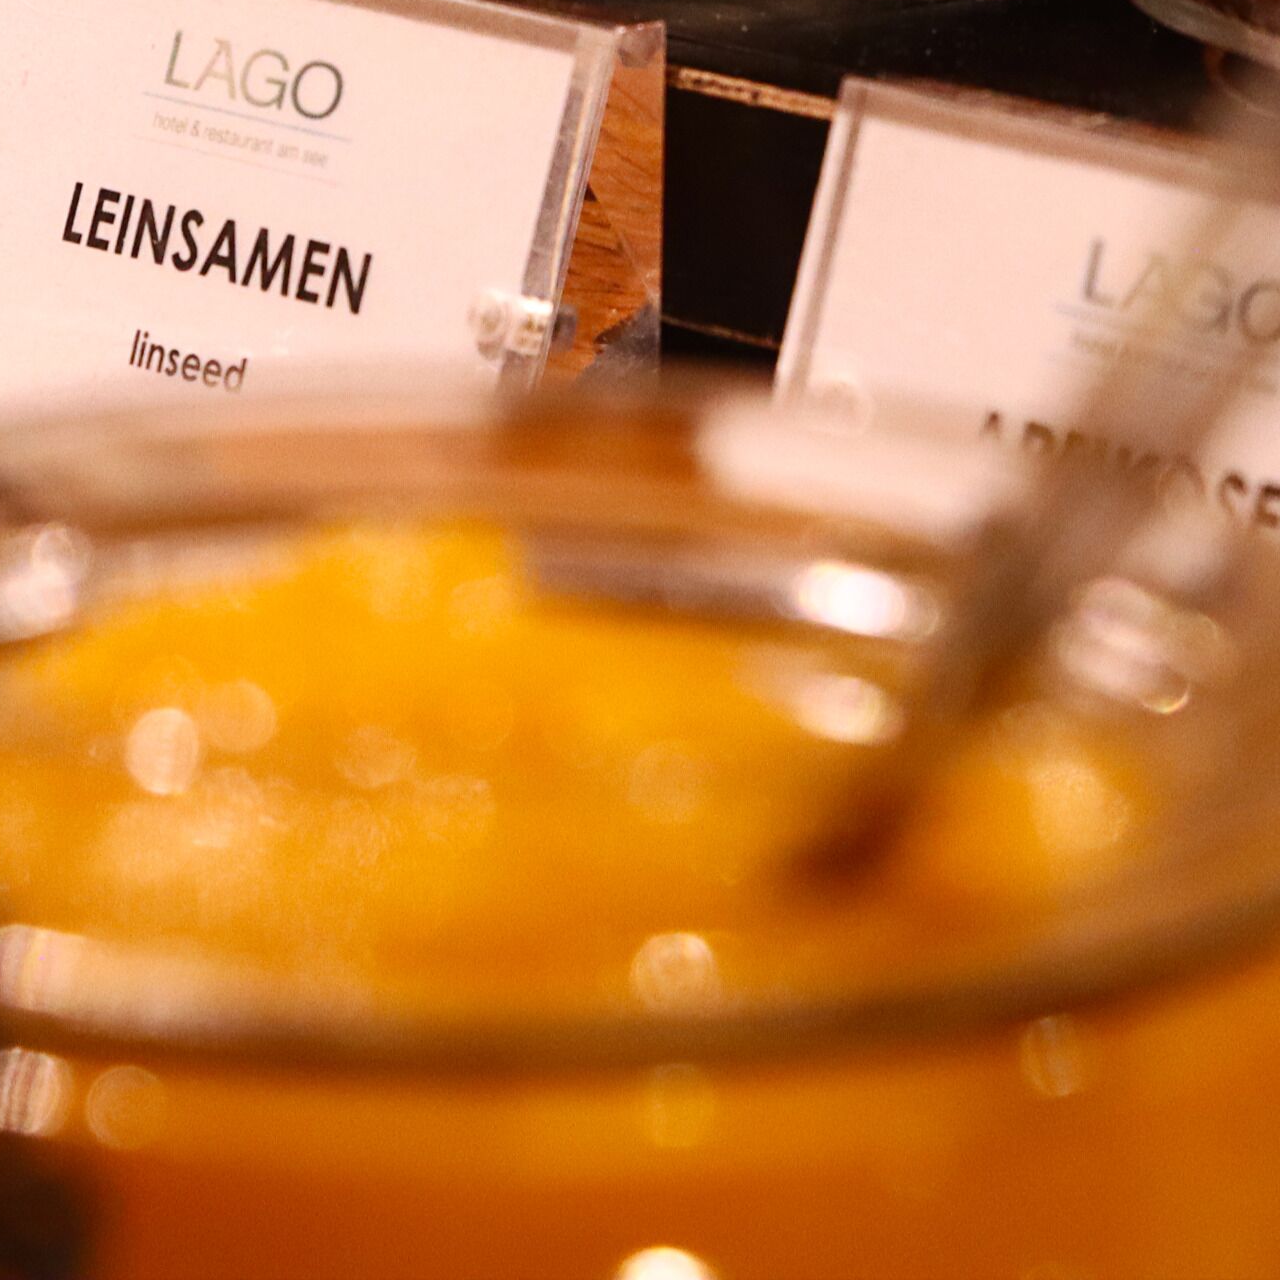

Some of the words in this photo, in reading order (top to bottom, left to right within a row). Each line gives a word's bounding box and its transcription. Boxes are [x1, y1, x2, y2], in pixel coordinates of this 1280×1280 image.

[163, 30, 345, 121] LAGO
[62, 181, 373, 315] LEINSAMEN
[129, 329, 249, 394] linseed
